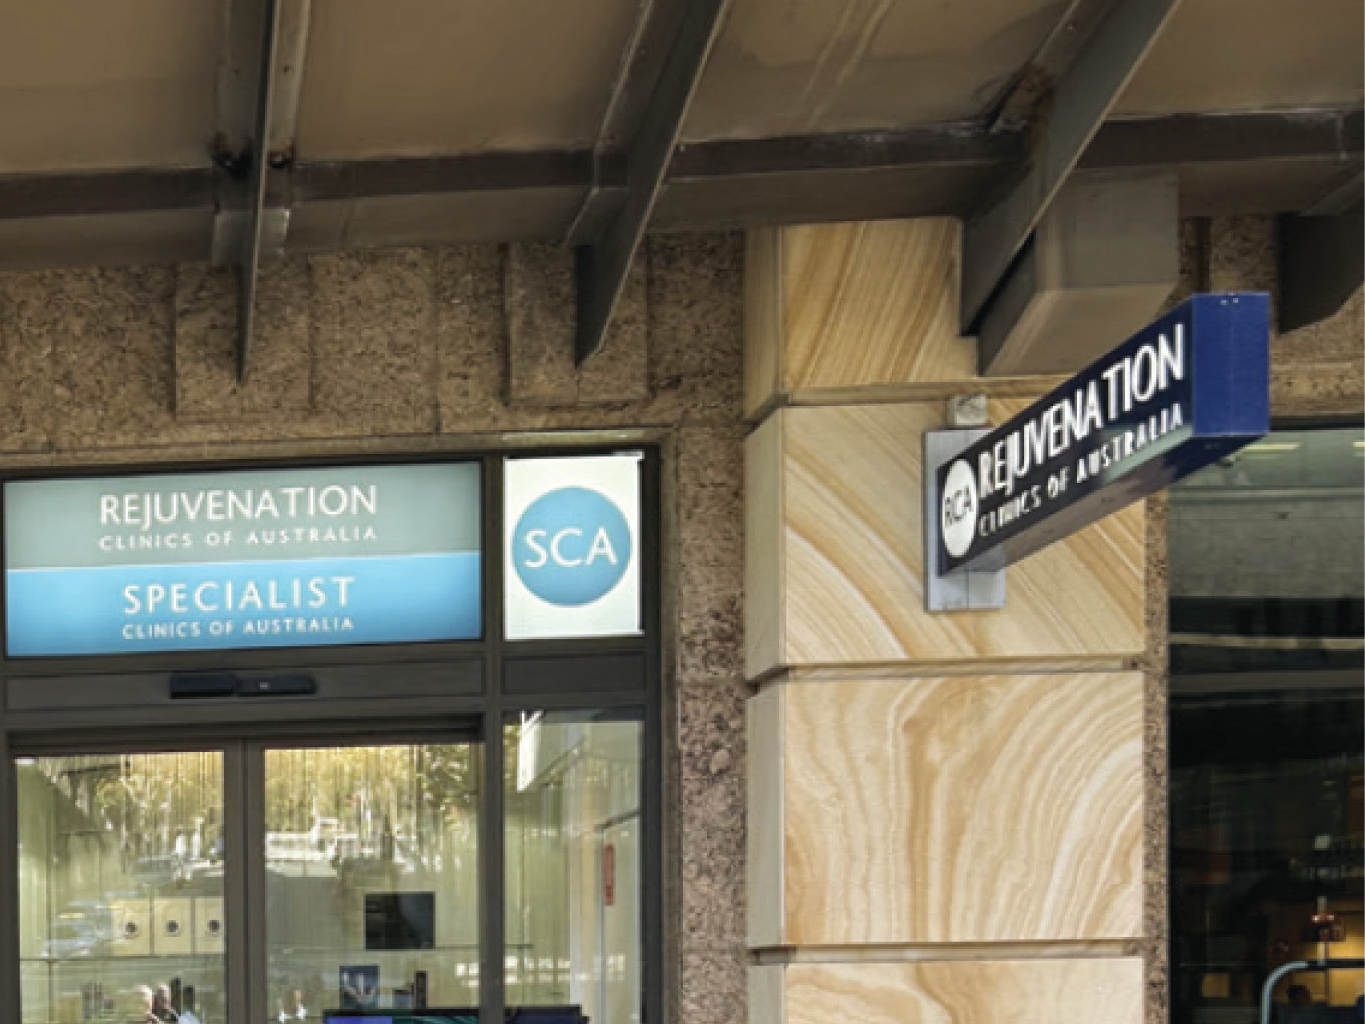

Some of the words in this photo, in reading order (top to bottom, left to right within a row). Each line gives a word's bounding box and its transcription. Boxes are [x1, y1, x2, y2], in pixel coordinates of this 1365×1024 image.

[979, 324, 1184, 498] REJUVENATION
[979, 485, 1042, 537] CLINICS
[1047, 466, 1071, 500] OF
[1077, 403, 1184, 483] AUSTRALIA
[99, 484, 378, 531] REJUVENATION
[99, 532, 193, 551] CLINICS
[204, 530, 233, 546] OF
[246, 526, 378, 545] AUSTRALIA
[523, 527, 619, 569] SCA
[122, 575, 356, 615] SPECIALIST
[122, 621, 201, 640] CLINICS
[209, 619, 233, 636] OF
[243, 616, 355, 635] AUSTRALIA
